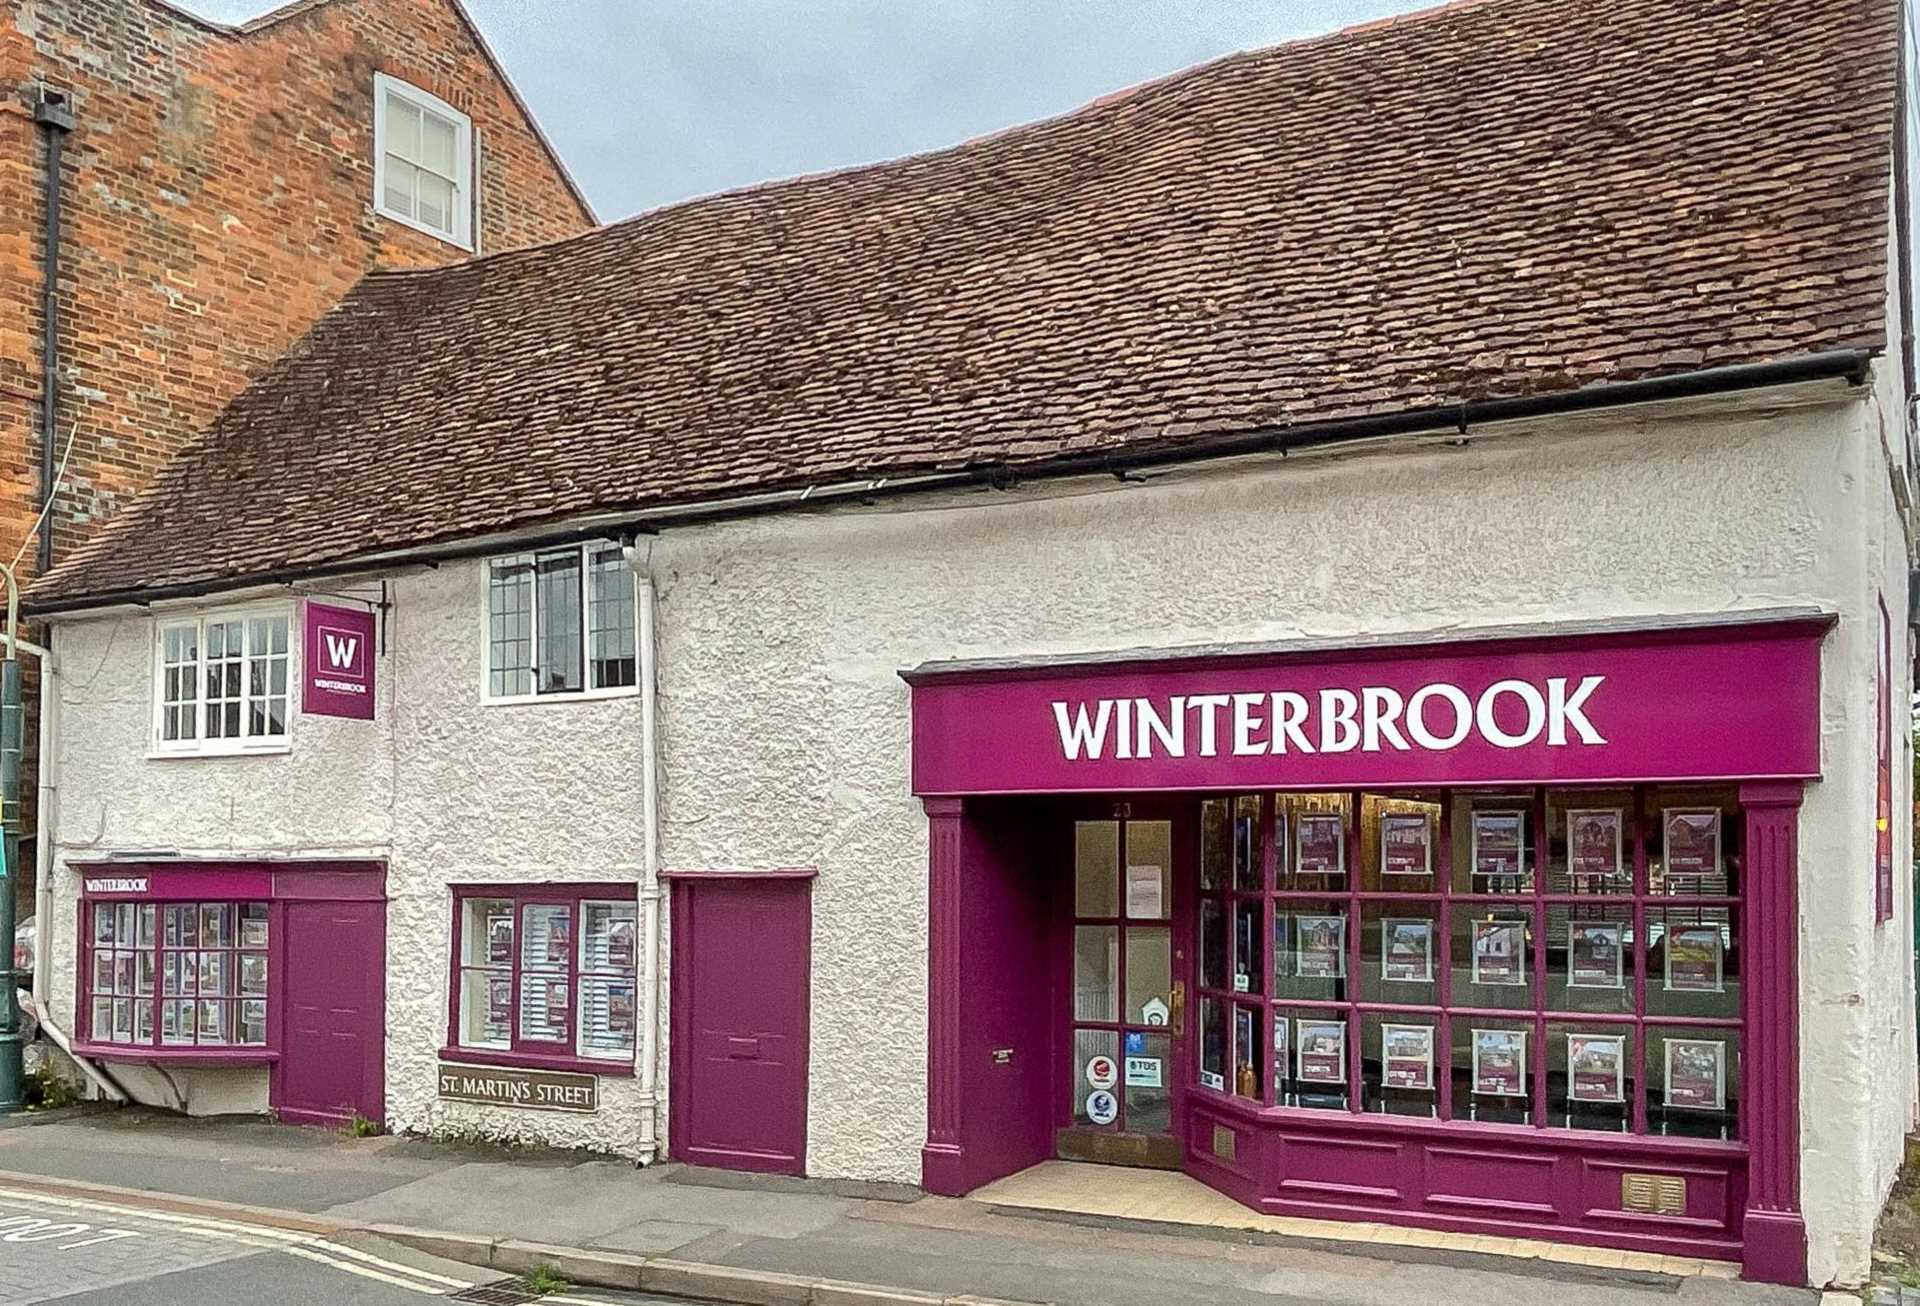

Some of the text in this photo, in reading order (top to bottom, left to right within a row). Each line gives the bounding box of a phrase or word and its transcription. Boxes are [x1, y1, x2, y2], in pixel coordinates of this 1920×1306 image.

[325, 634, 357, 669] W
[314, 678, 367, 694] WINTERBROOK
[1051, 675, 1608, 760] WINTERBROOK
[85, 878, 147, 892] WINTERBROOK
[440, 1075, 592, 1105] ST. MARTIN'S STREET
